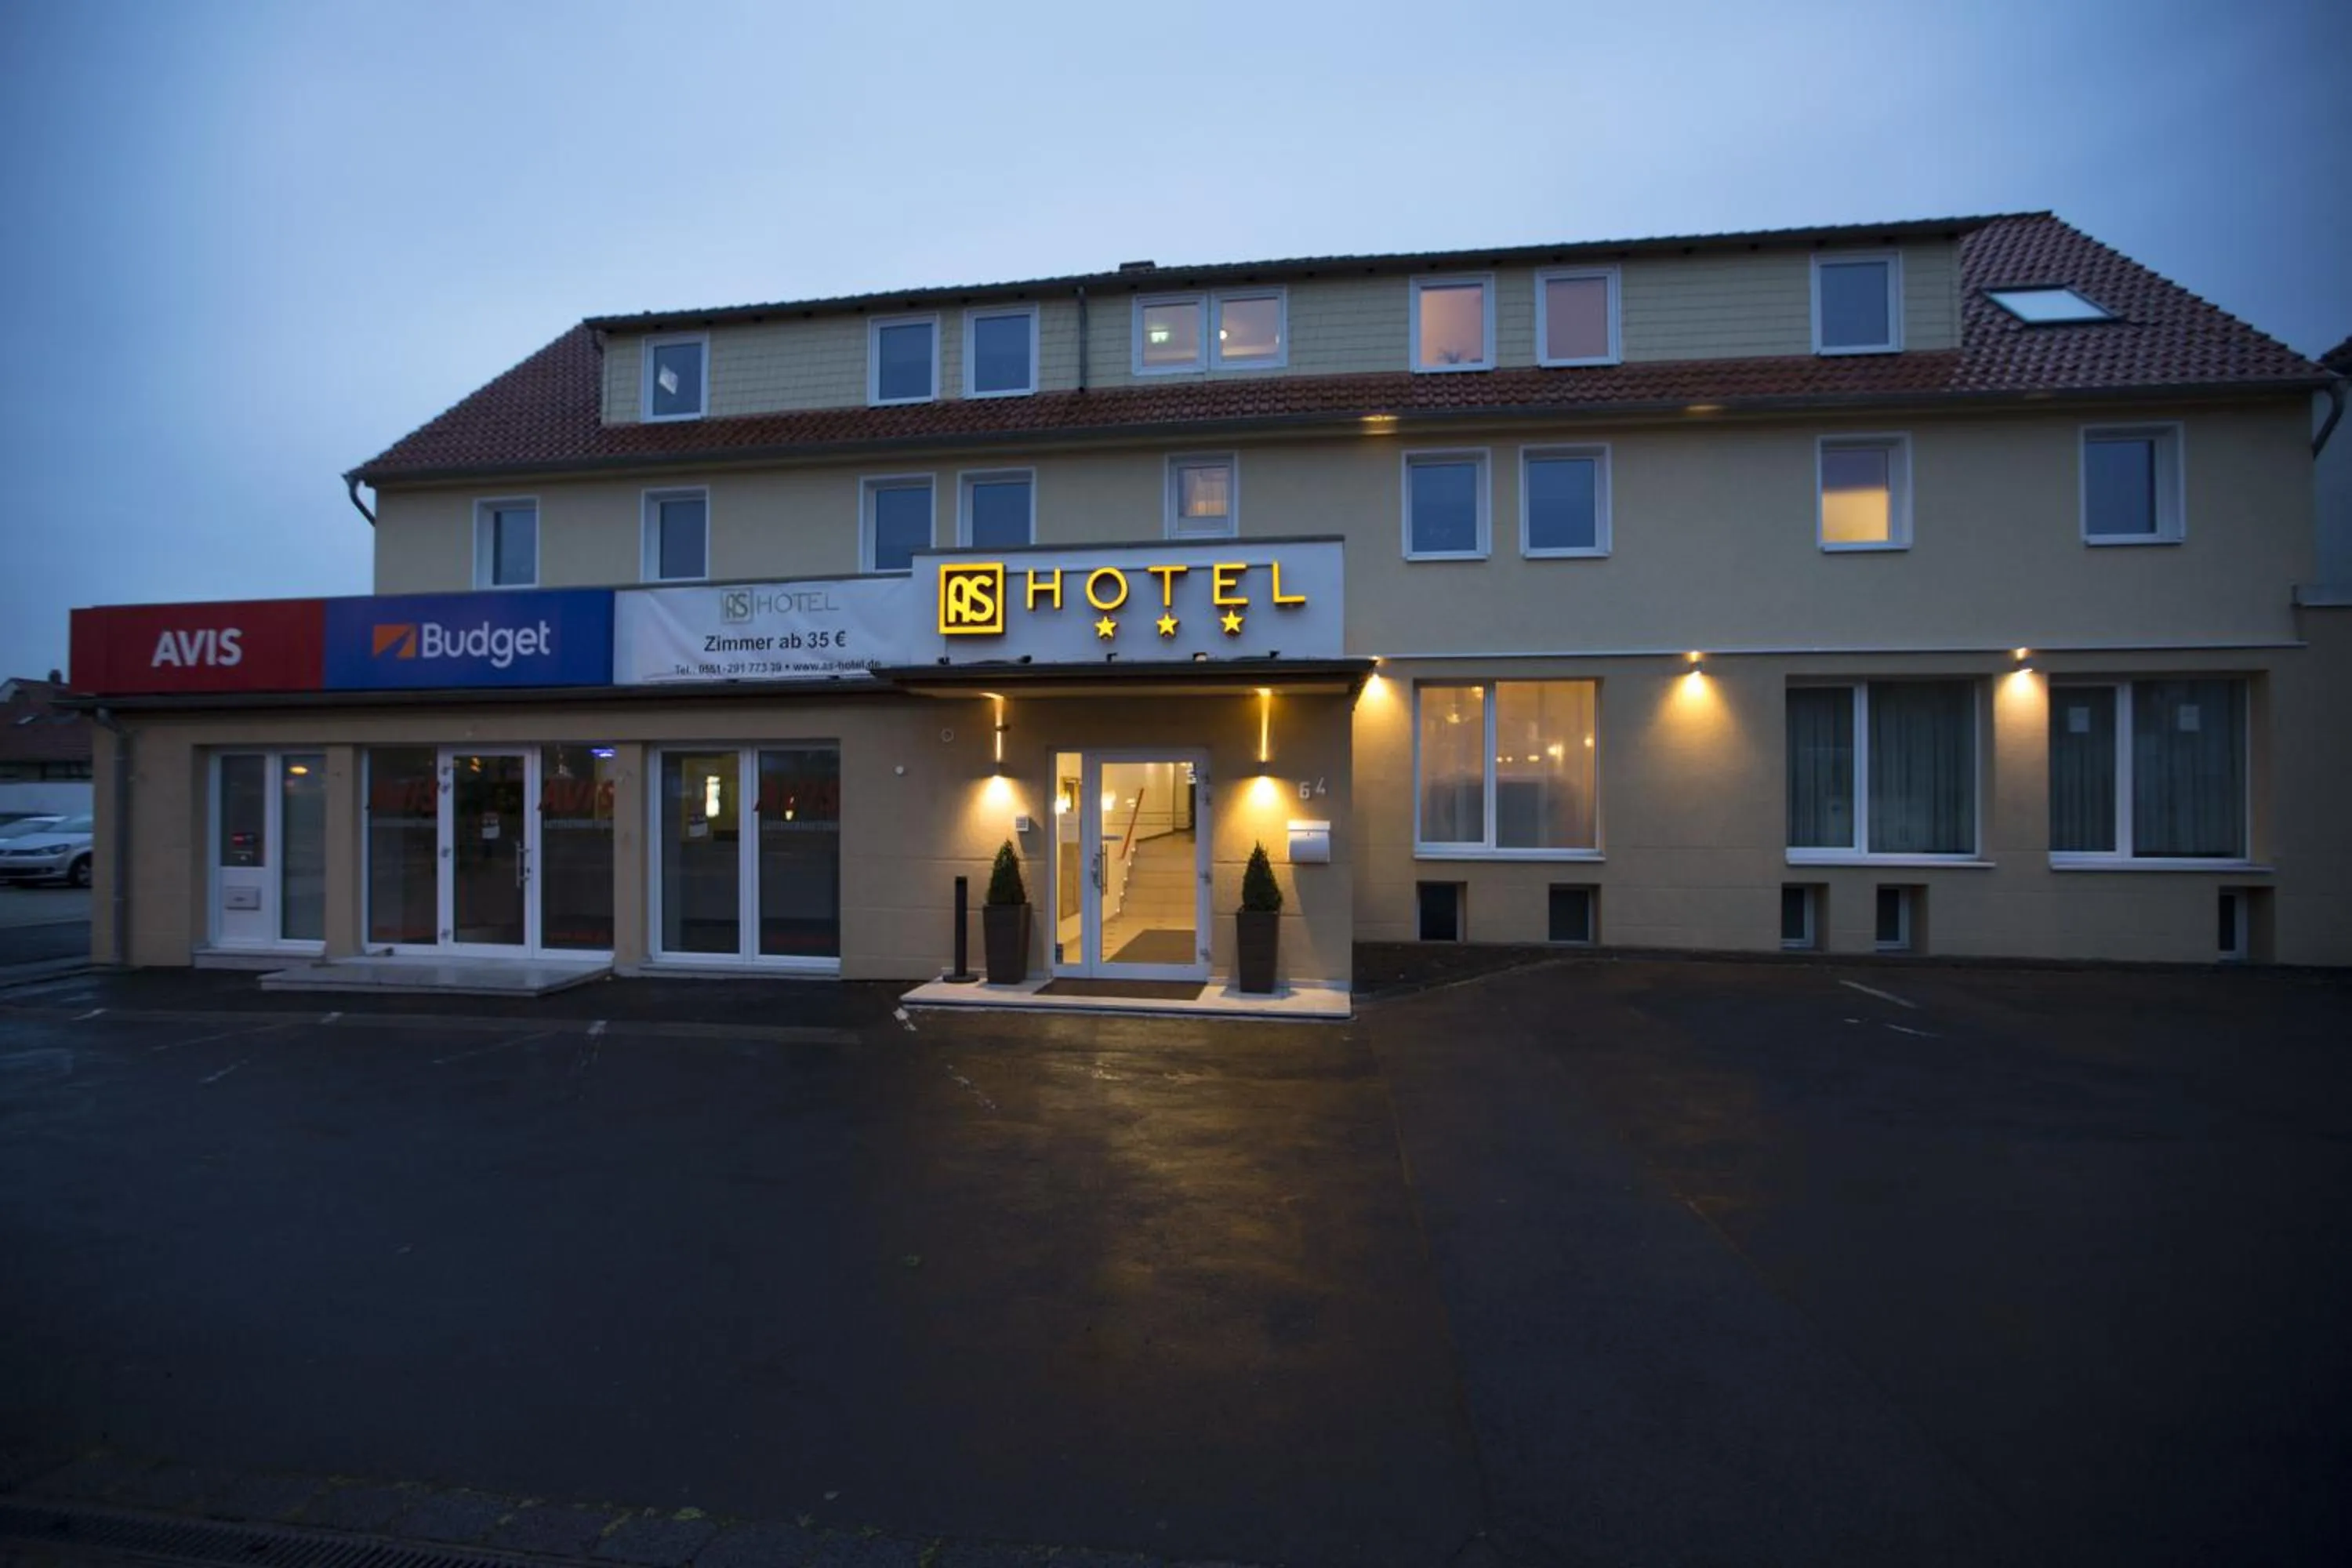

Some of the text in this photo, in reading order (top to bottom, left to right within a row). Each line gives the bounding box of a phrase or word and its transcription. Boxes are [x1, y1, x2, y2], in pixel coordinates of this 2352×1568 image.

[1026, 561, 1306, 611] HOTEL
[757, 592, 840, 614] HOTEL
[151, 627, 242, 667] AVIS
[422, 620, 550, 668] Budget
[704, 630, 847, 652] Zimmer ab 35 €
[1299, 778, 1326, 800] 64
